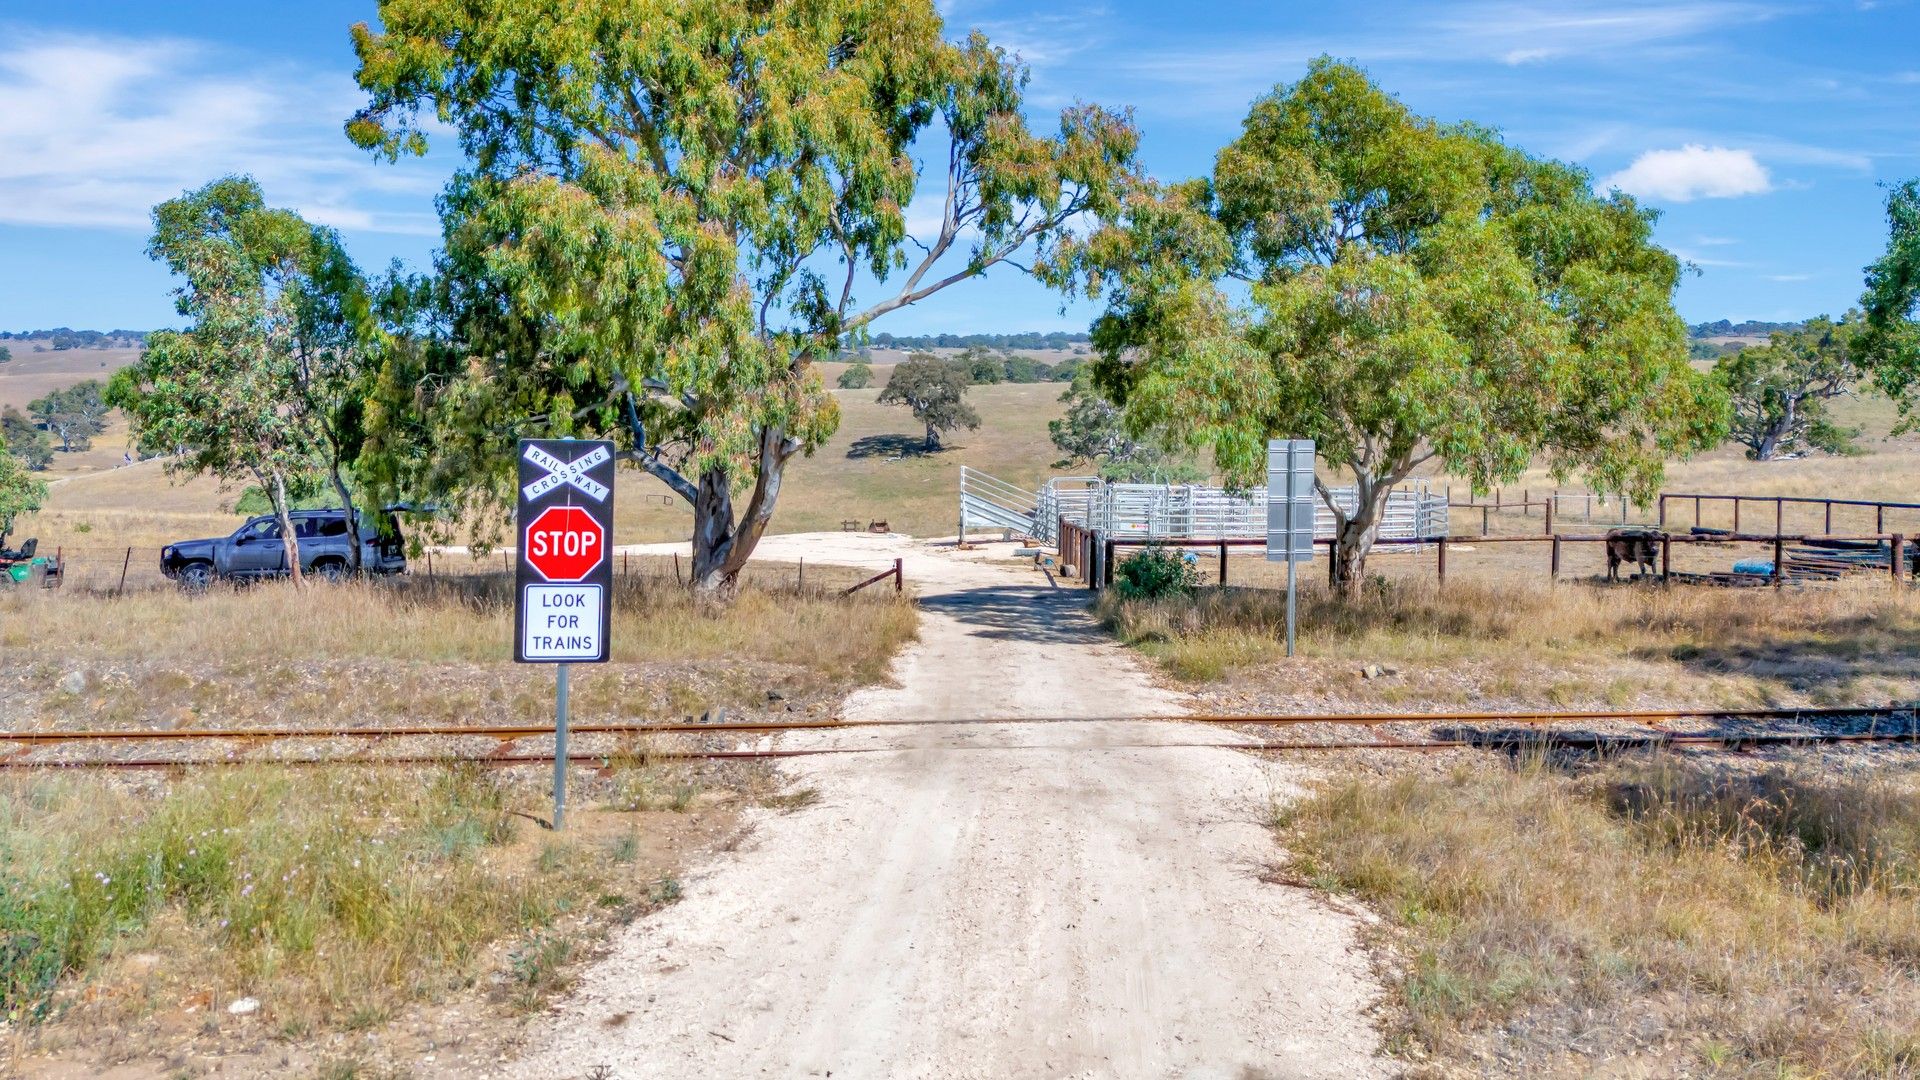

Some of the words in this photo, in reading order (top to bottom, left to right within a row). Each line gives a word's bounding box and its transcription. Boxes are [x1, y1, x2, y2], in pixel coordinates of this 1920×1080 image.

[532, 452, 602, 494] CROSSING
[532, 530, 597, 557] STOP
[542, 593, 586, 608] LOOK
[547, 614, 580, 629] FOR
[532, 636, 593, 650] TRAINS
